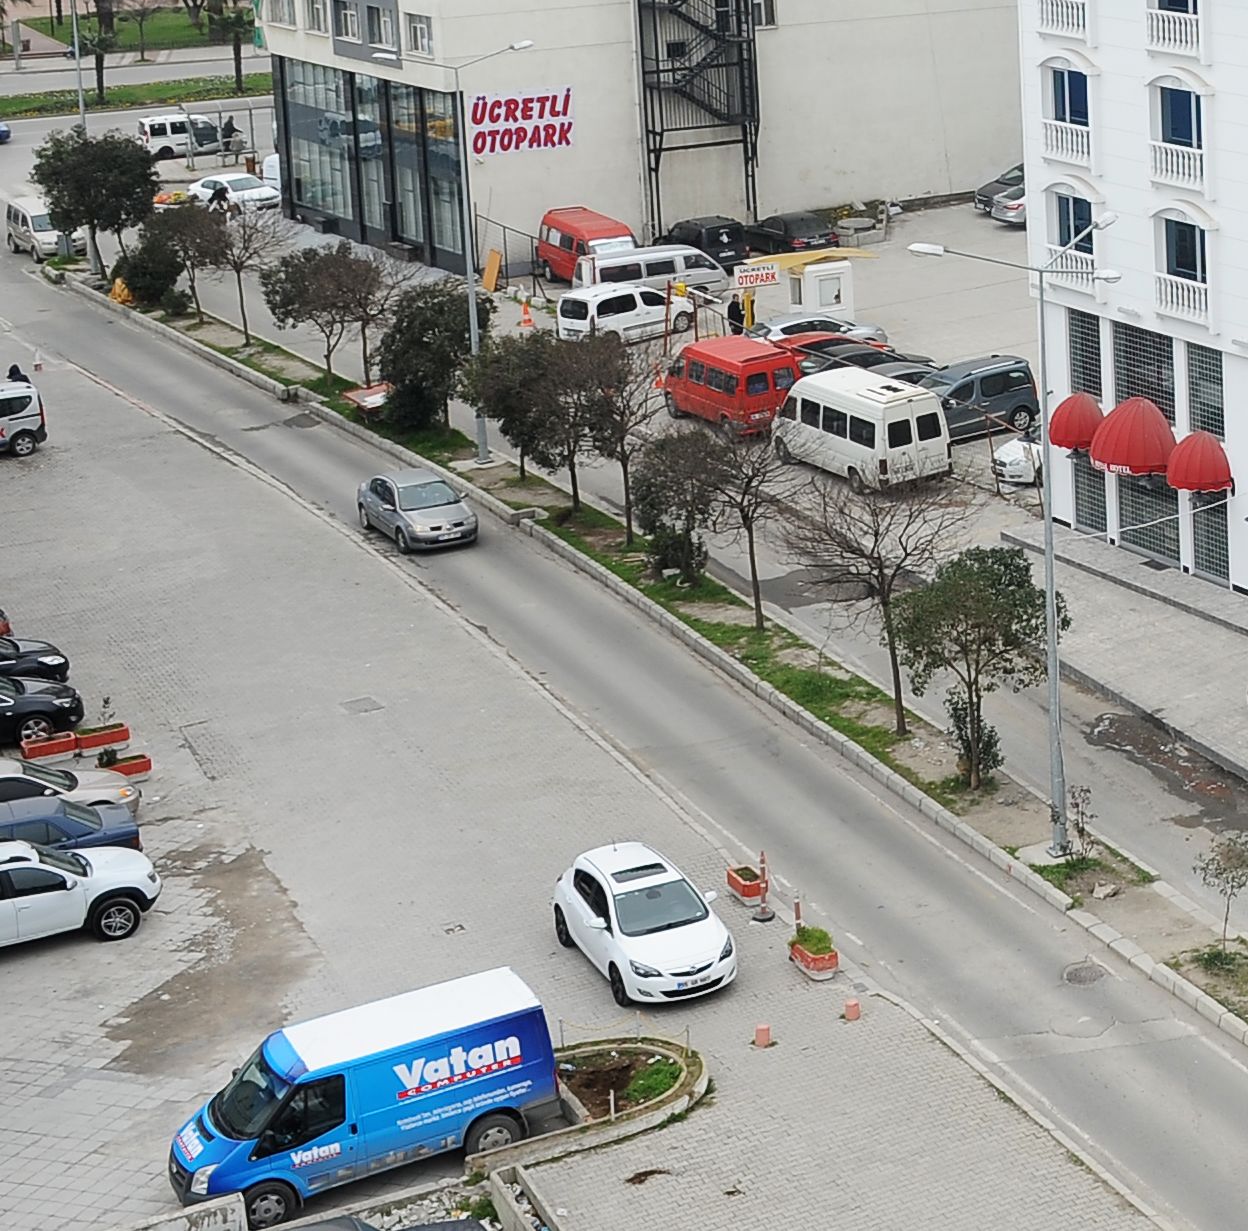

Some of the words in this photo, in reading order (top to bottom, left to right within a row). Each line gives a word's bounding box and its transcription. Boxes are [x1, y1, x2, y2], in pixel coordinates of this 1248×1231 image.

[471, 87, 571, 126] ÜCRETLİ
[472, 121, 573, 155] OTOPARK
[737, 272, 777, 286] OTOPARK
[393, 1036, 521, 1089] Vatan
[407, 1058, 513, 1096] COMPUTER
[290, 1142, 341, 1165] Vatan
